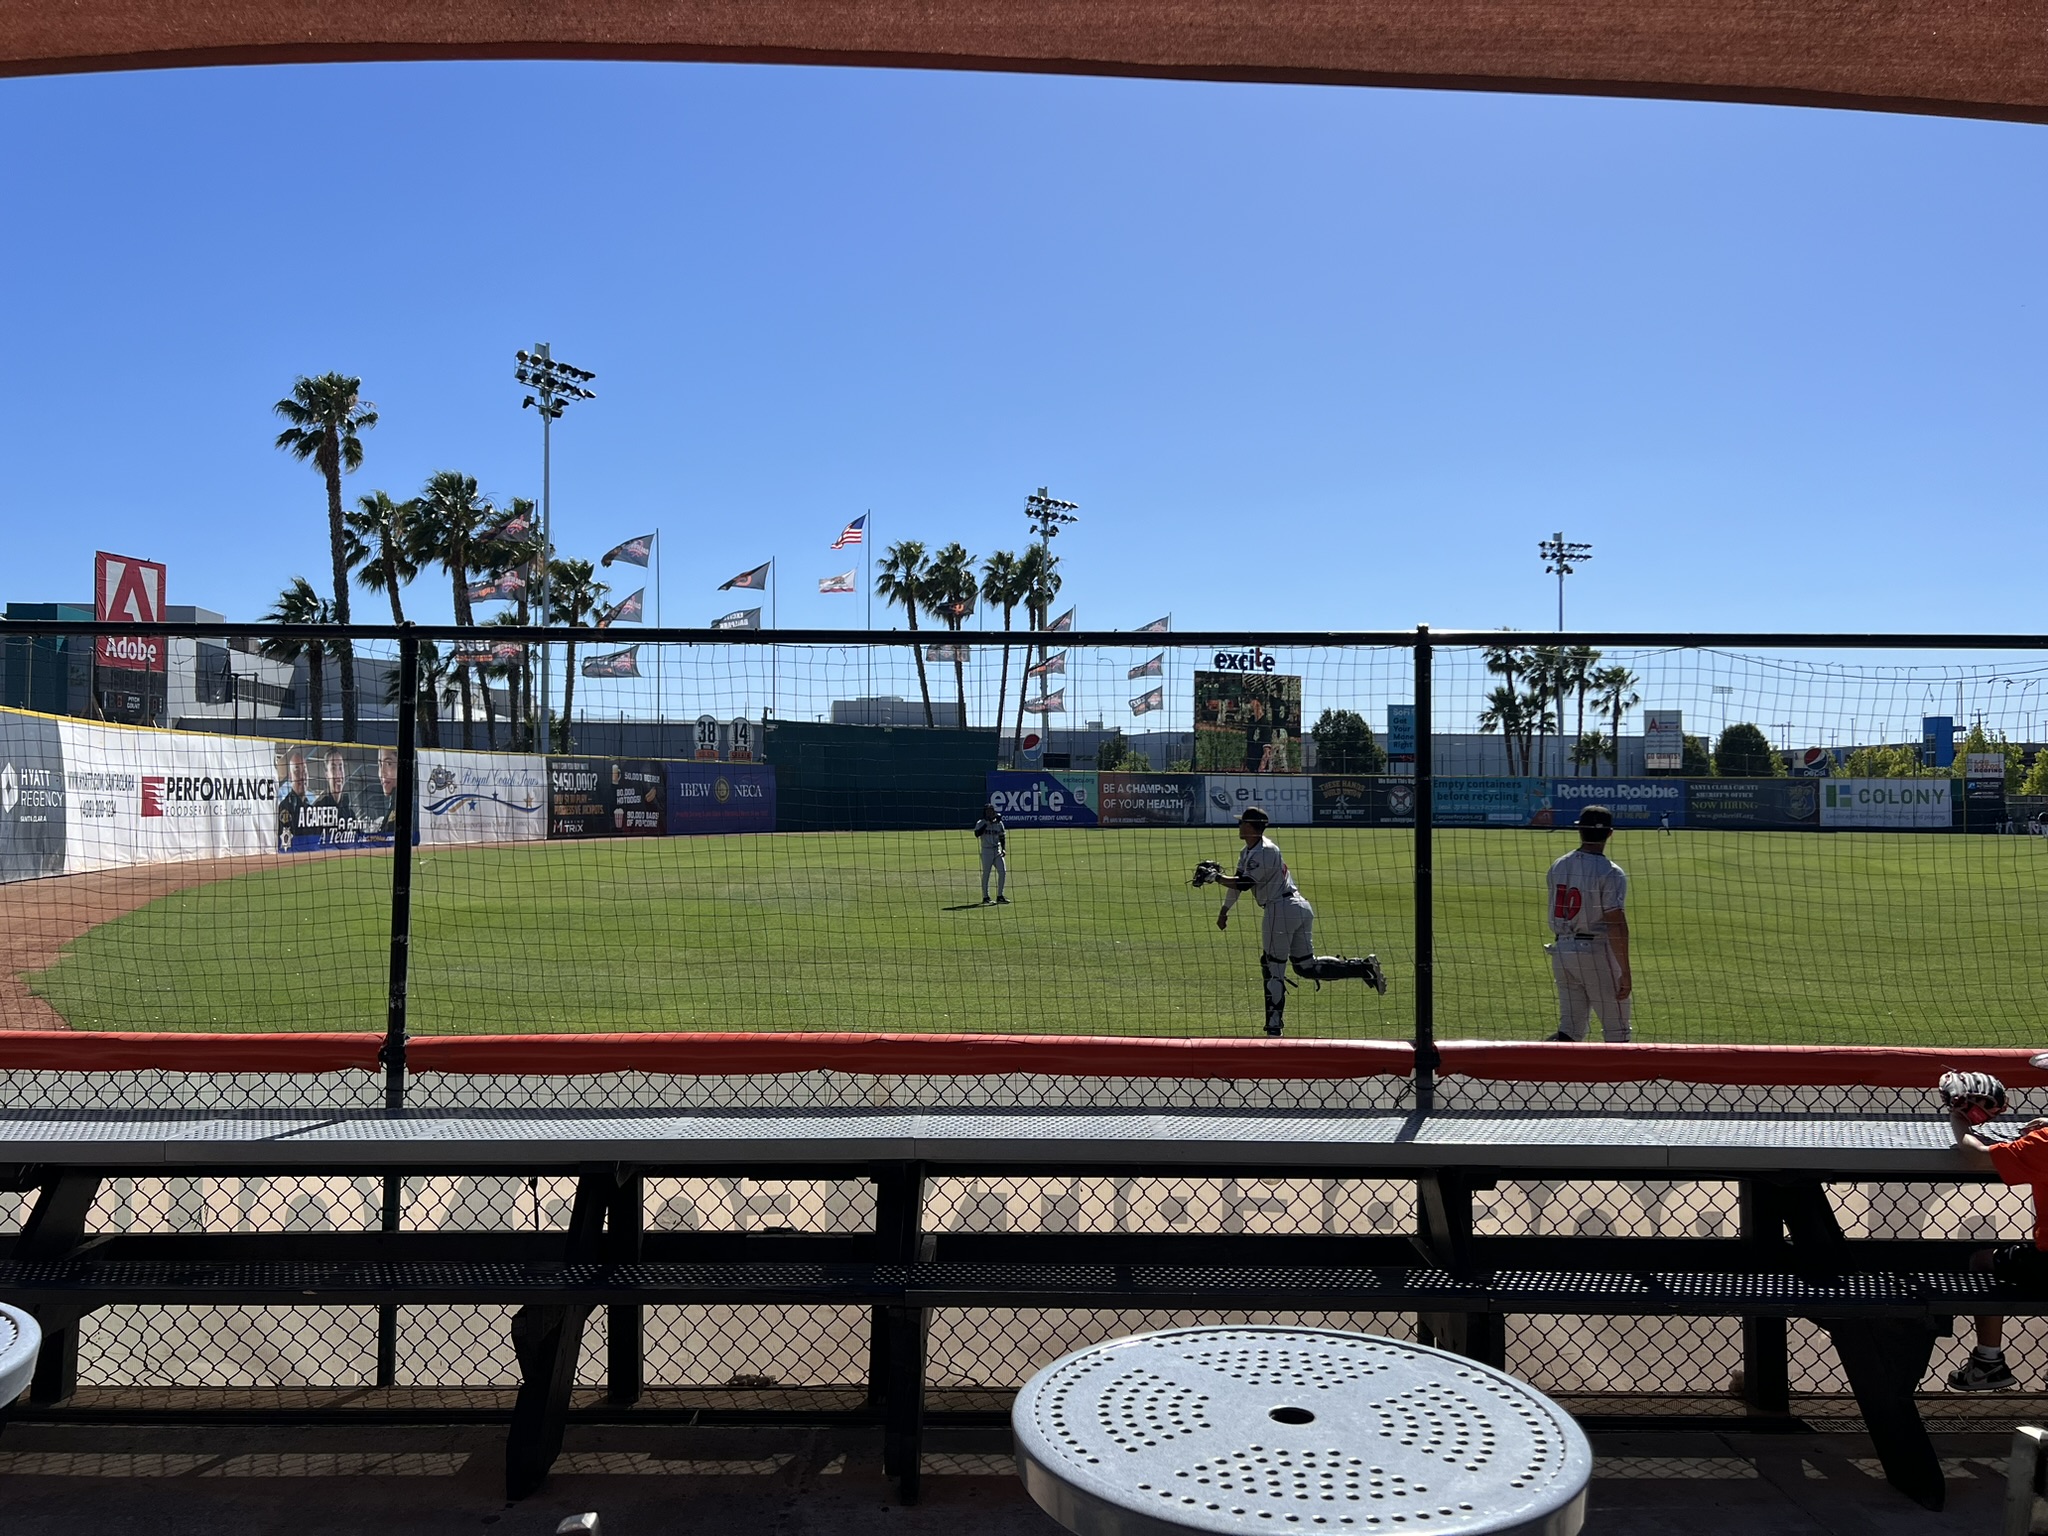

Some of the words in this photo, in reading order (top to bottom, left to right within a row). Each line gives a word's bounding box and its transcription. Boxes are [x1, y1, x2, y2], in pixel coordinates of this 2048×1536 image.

[106, 636, 156, 663] Adobe
[1214, 647, 1275, 672] excite
[698, 721, 716, 743] 38
[734, 722, 748, 744] 14
[21, 769, 50, 787] HYATT
[552, 771, 598, 793] $450,000?
[1433, 780, 1465, 790] Empty
[1467, 780, 1522, 789] containers
[167, 776, 275, 801] PERFORMANCE
[680, 783, 711, 797] IBEW
[734, 784, 763, 797] NECA
[990, 781, 1064, 812] excite
[1103, 784, 1115, 793] BE
[1117, 784, 1124, 793] A
[1126, 784, 1179, 793] CHAMPION
[1437, 791, 1469, 801] before
[1472, 791, 1519, 803] recycling
[1557, 784, 1615, 800] Rotten
[1617, 784, 1679, 800] Robbie
[1859, 788, 1945, 804] COLONY
[21, 790, 64, 807] REGENCY
[1103, 799, 1117, 809] OF
[1119, 799, 1145, 809] YOUR
[1147, 799, 1183, 809] HEALTH
[1692, 801, 1716, 809] NOW
[1719, 801, 1758, 809] HIRING
[298, 807, 305, 828] A
[306, 807, 338, 828] CAREER
[328, 828, 357, 845] Team
